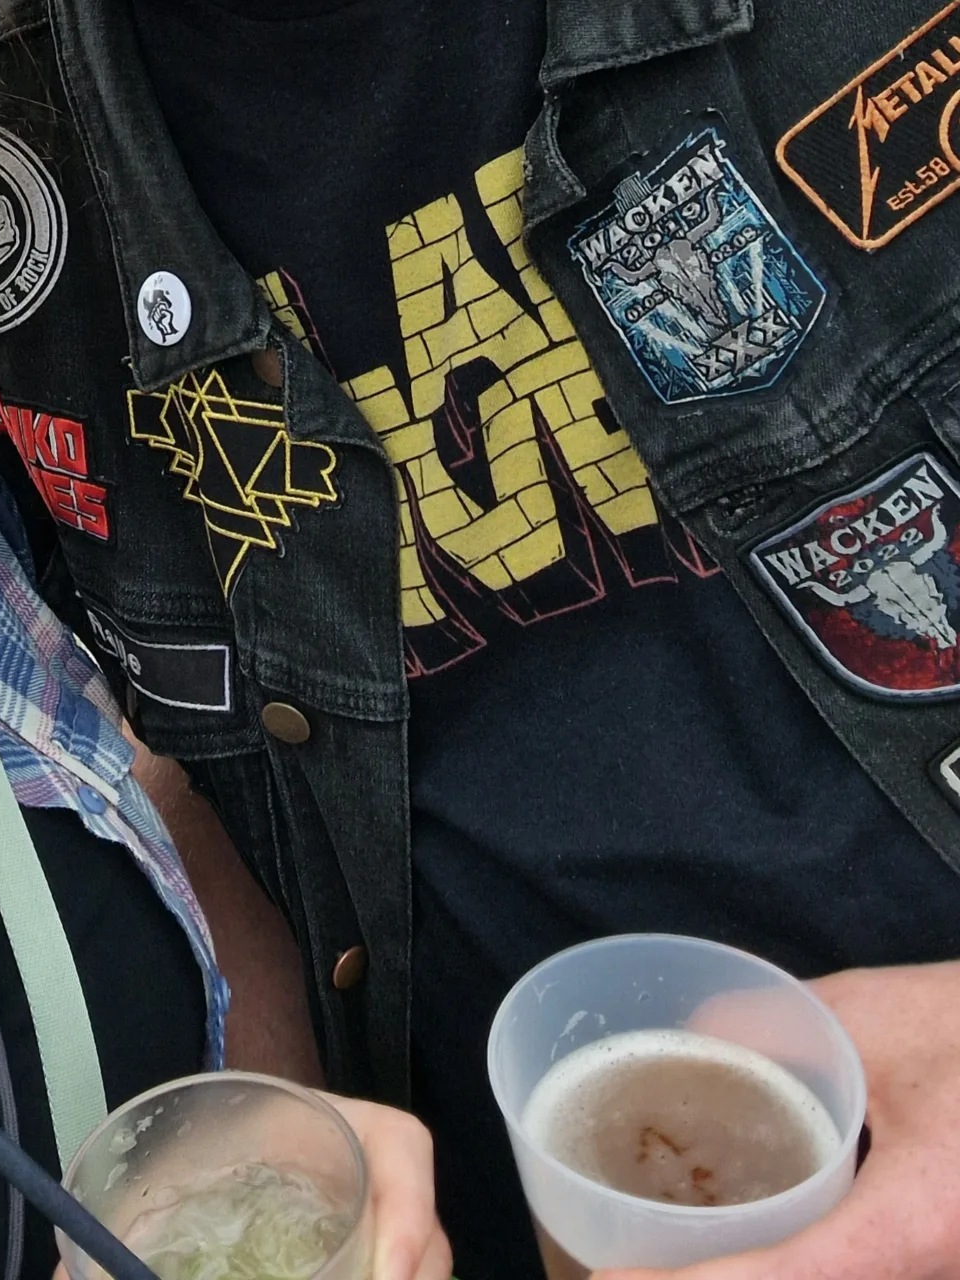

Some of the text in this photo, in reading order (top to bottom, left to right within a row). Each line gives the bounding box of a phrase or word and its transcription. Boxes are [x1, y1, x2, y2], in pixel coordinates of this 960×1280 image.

[579, 144, 724, 268] WACKEN
[620, 200, 702, 267] 2019
[14, 247, 49, 293] ROCK
[764, 464, 945, 586] WACKEN
[829, 528, 924, 587] 2022
